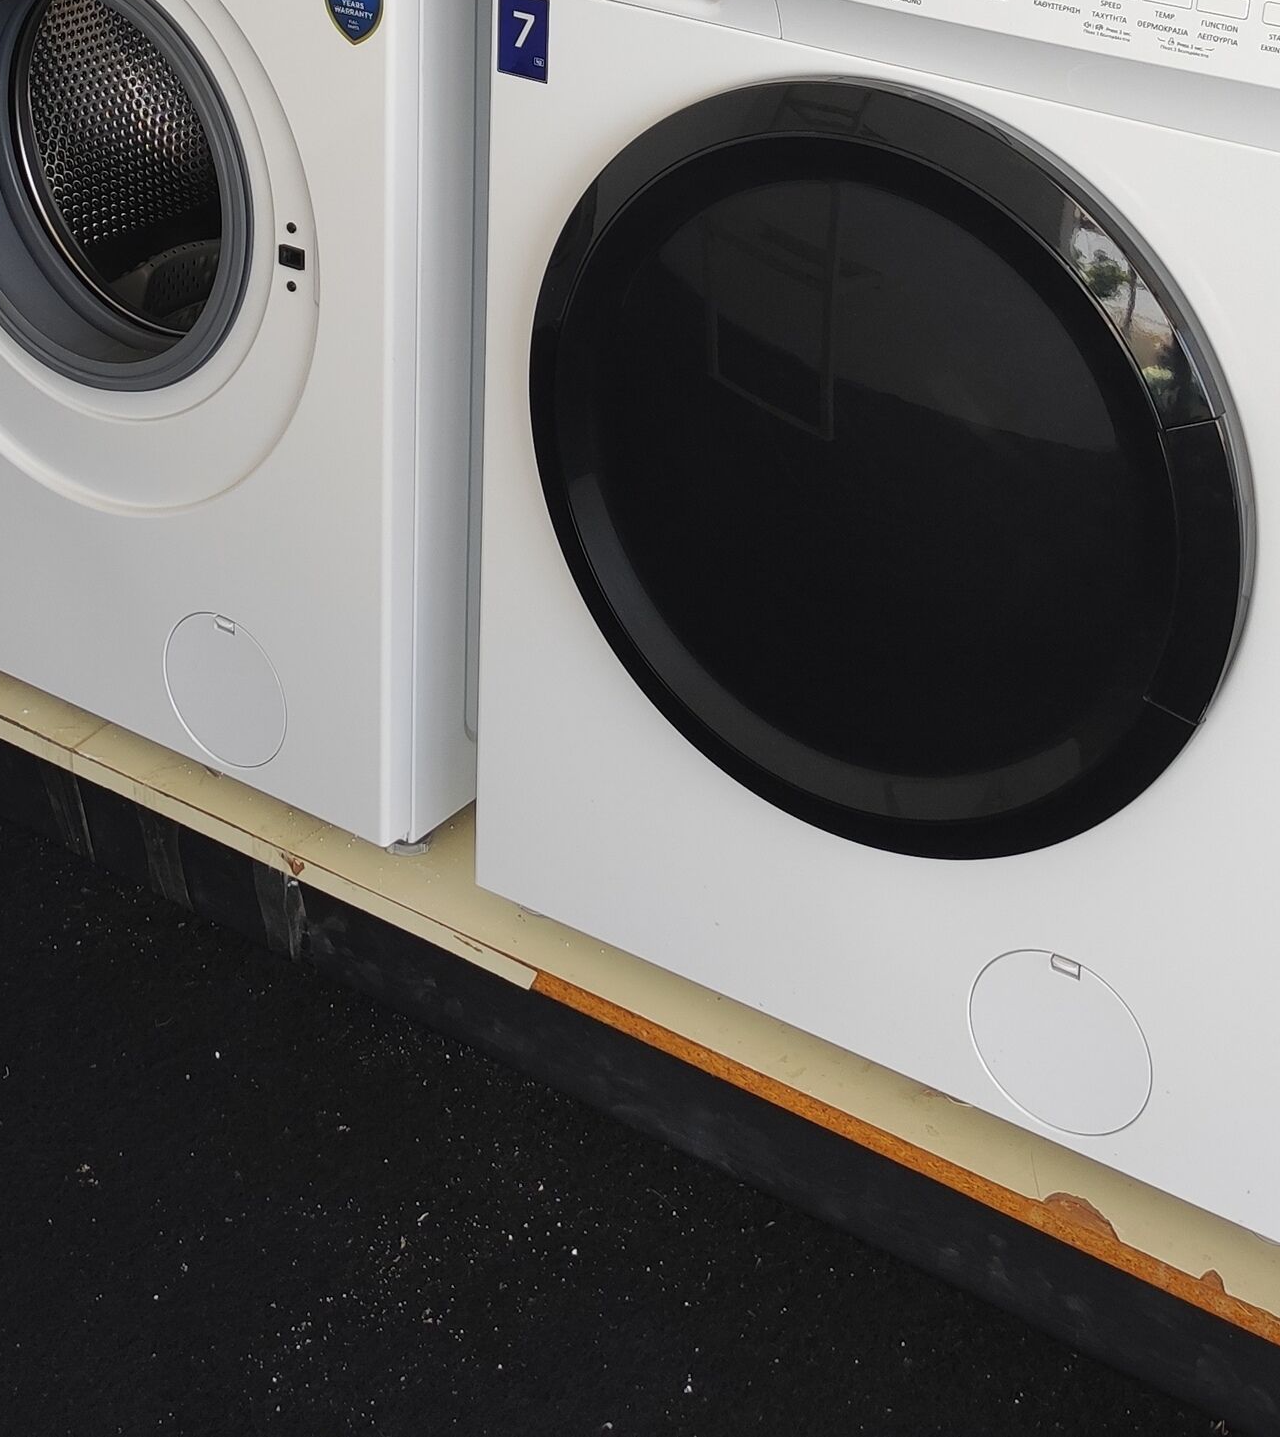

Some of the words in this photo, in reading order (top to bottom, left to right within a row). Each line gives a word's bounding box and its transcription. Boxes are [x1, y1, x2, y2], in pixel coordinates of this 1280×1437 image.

[1100, 0, 1122, 10] SPEED
[334, 5, 374, 20] WARRANTY
[1154, 10, 1176, 20] TEMP
[513, 10, 535, 48] 7
[1200, 19, 1239, 33] FUNCTION
